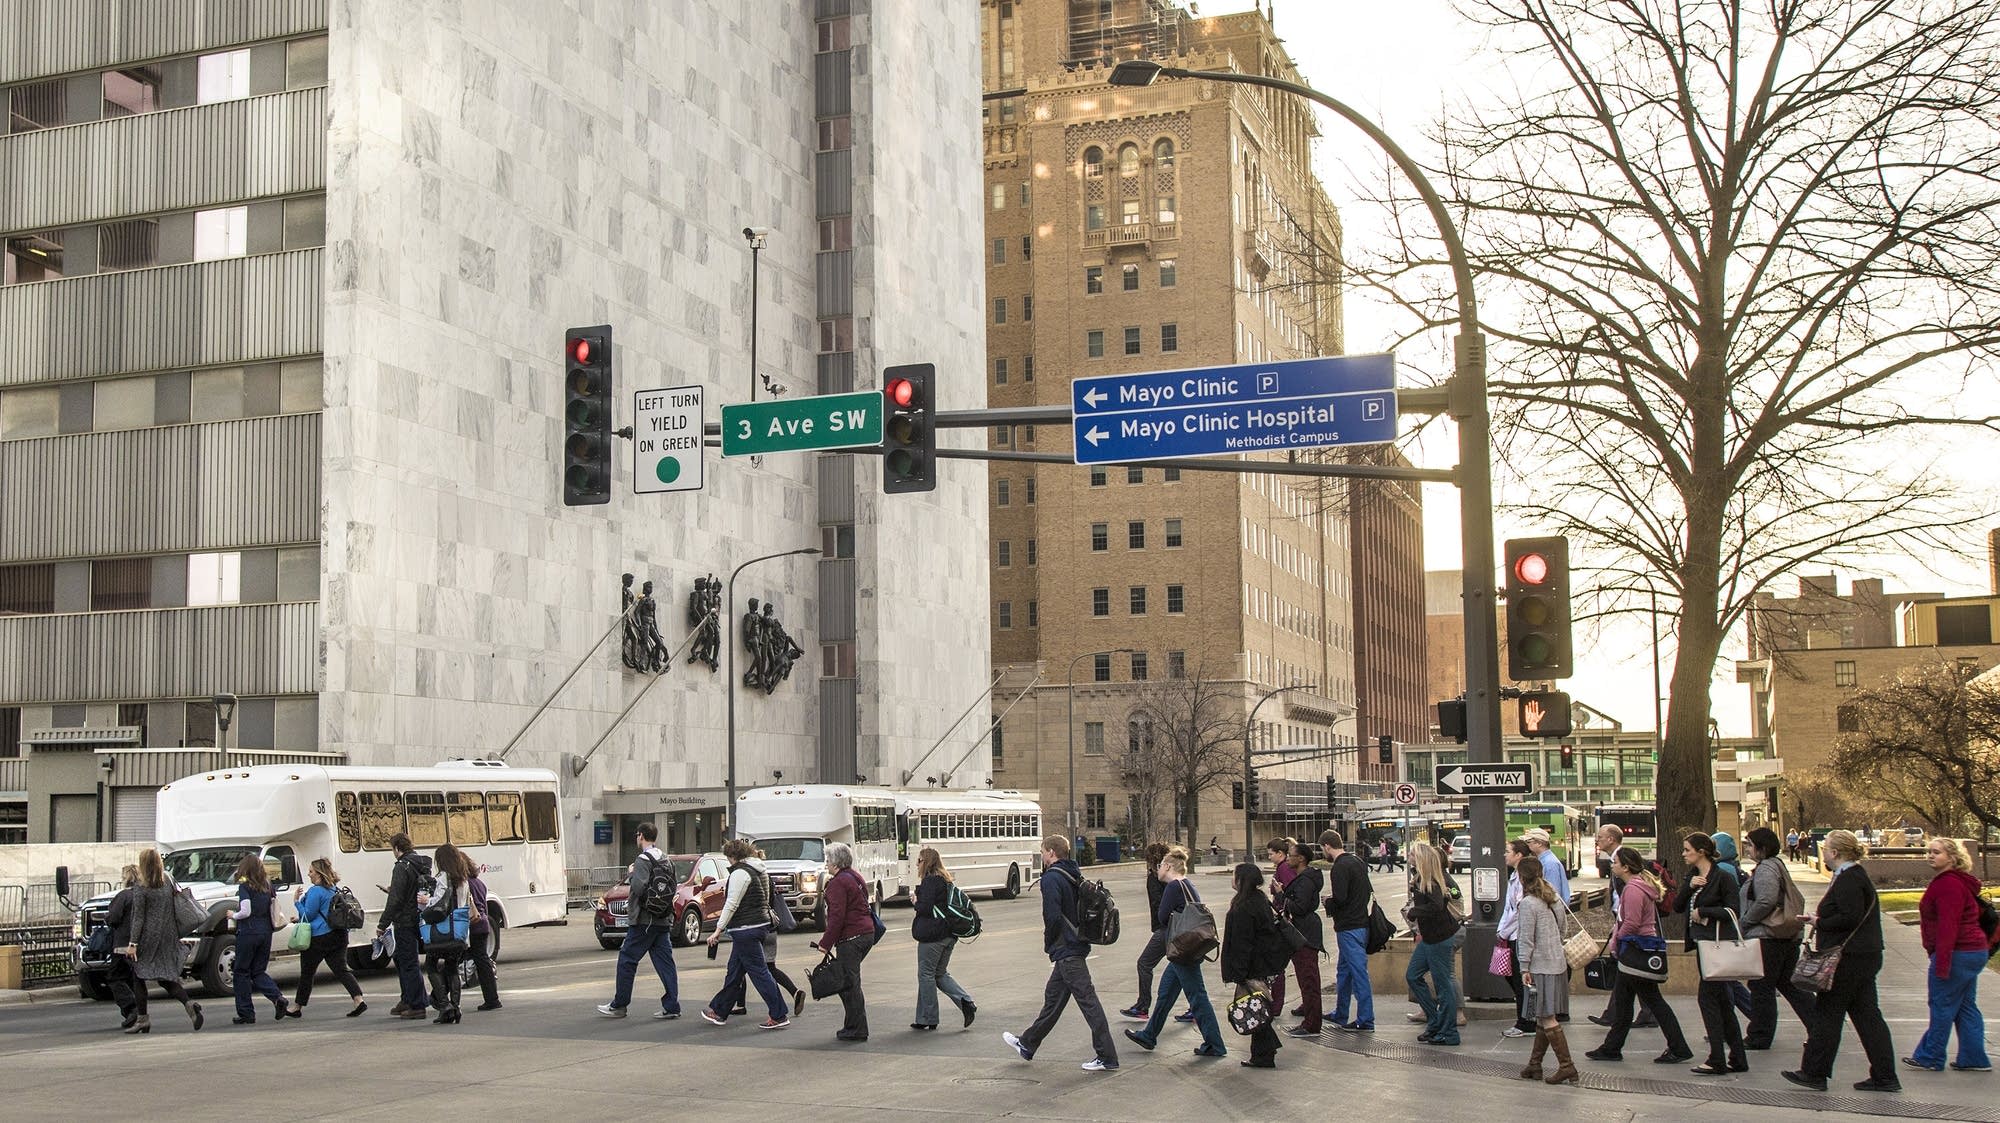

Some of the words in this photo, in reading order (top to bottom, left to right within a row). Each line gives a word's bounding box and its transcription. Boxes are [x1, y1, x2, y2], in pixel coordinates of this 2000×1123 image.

[1120, 385, 1174, 406] Mayo
[1182, 377, 1238, 398] Clinic
[1262, 376, 1273, 391] P
[639, 397, 664, 410] LEFT
[671, 394, 698, 408] TURN
[651, 415, 687, 431] YIELD
[738, 420, 752, 439] 3
[767, 417, 814, 437] Ave
[829, 409, 866, 431] SW
[1121, 419, 1175, 441] Mayo
[1183, 412, 1240, 433] Clinic
[1247, 404, 1334, 430] Hospital
[1368, 403, 1379, 416] P
[640, 440, 654, 452] ON
[663, 437, 697, 450] GREEN
[1226, 434, 1285, 448] Methodist
[1290, 432, 1339, 446] Campus
[1464, 774, 1490, 785] ONE
[1494, 773, 1521, 785] WAY
[317, 802, 326, 814] 58
[660, 797, 678, 805] Mayo
[678, 796, 706, 805] Building
